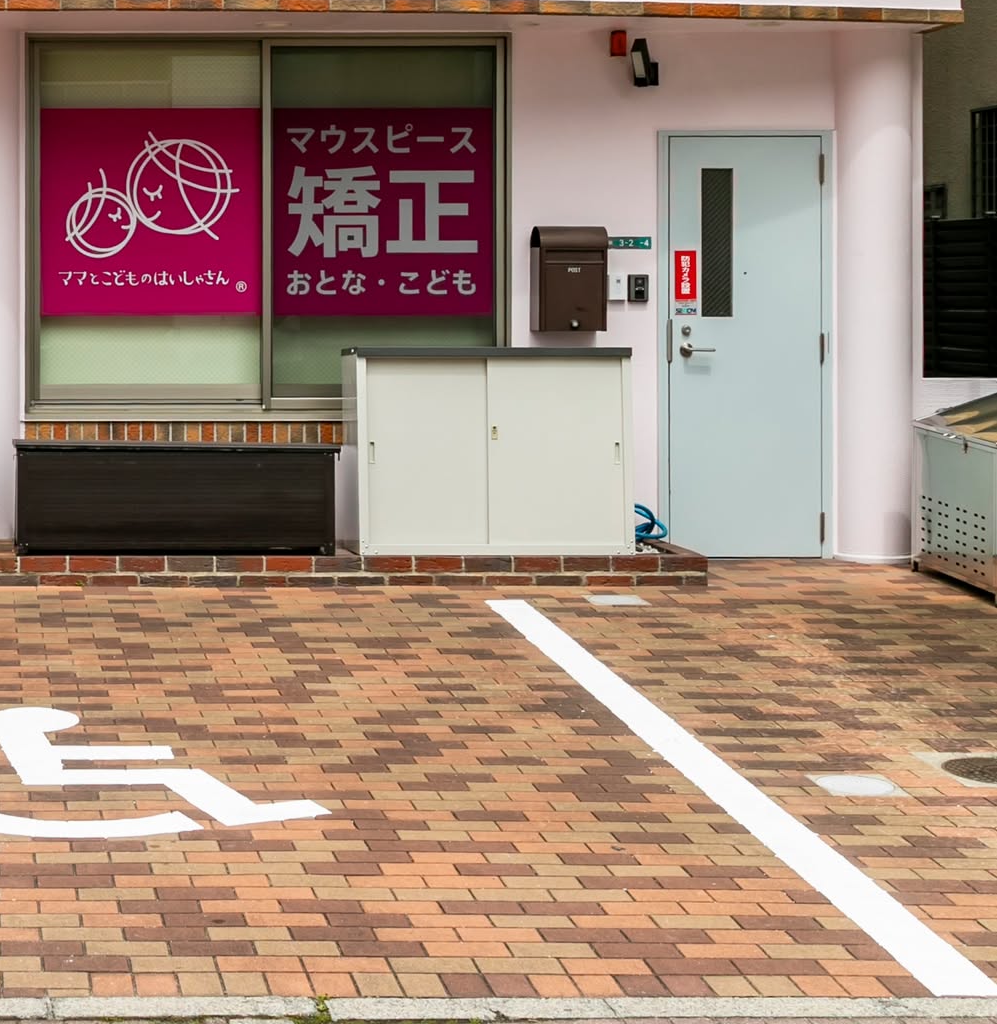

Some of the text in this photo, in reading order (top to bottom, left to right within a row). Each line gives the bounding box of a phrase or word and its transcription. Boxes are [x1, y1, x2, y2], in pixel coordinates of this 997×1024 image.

[287, 123, 477, 154] マウスピース
[287, 166, 478, 258] 矯正
[58, 271, 230, 287] ママとこどものはいしゃさん
[286, 270, 477, 295] おとな・こども
